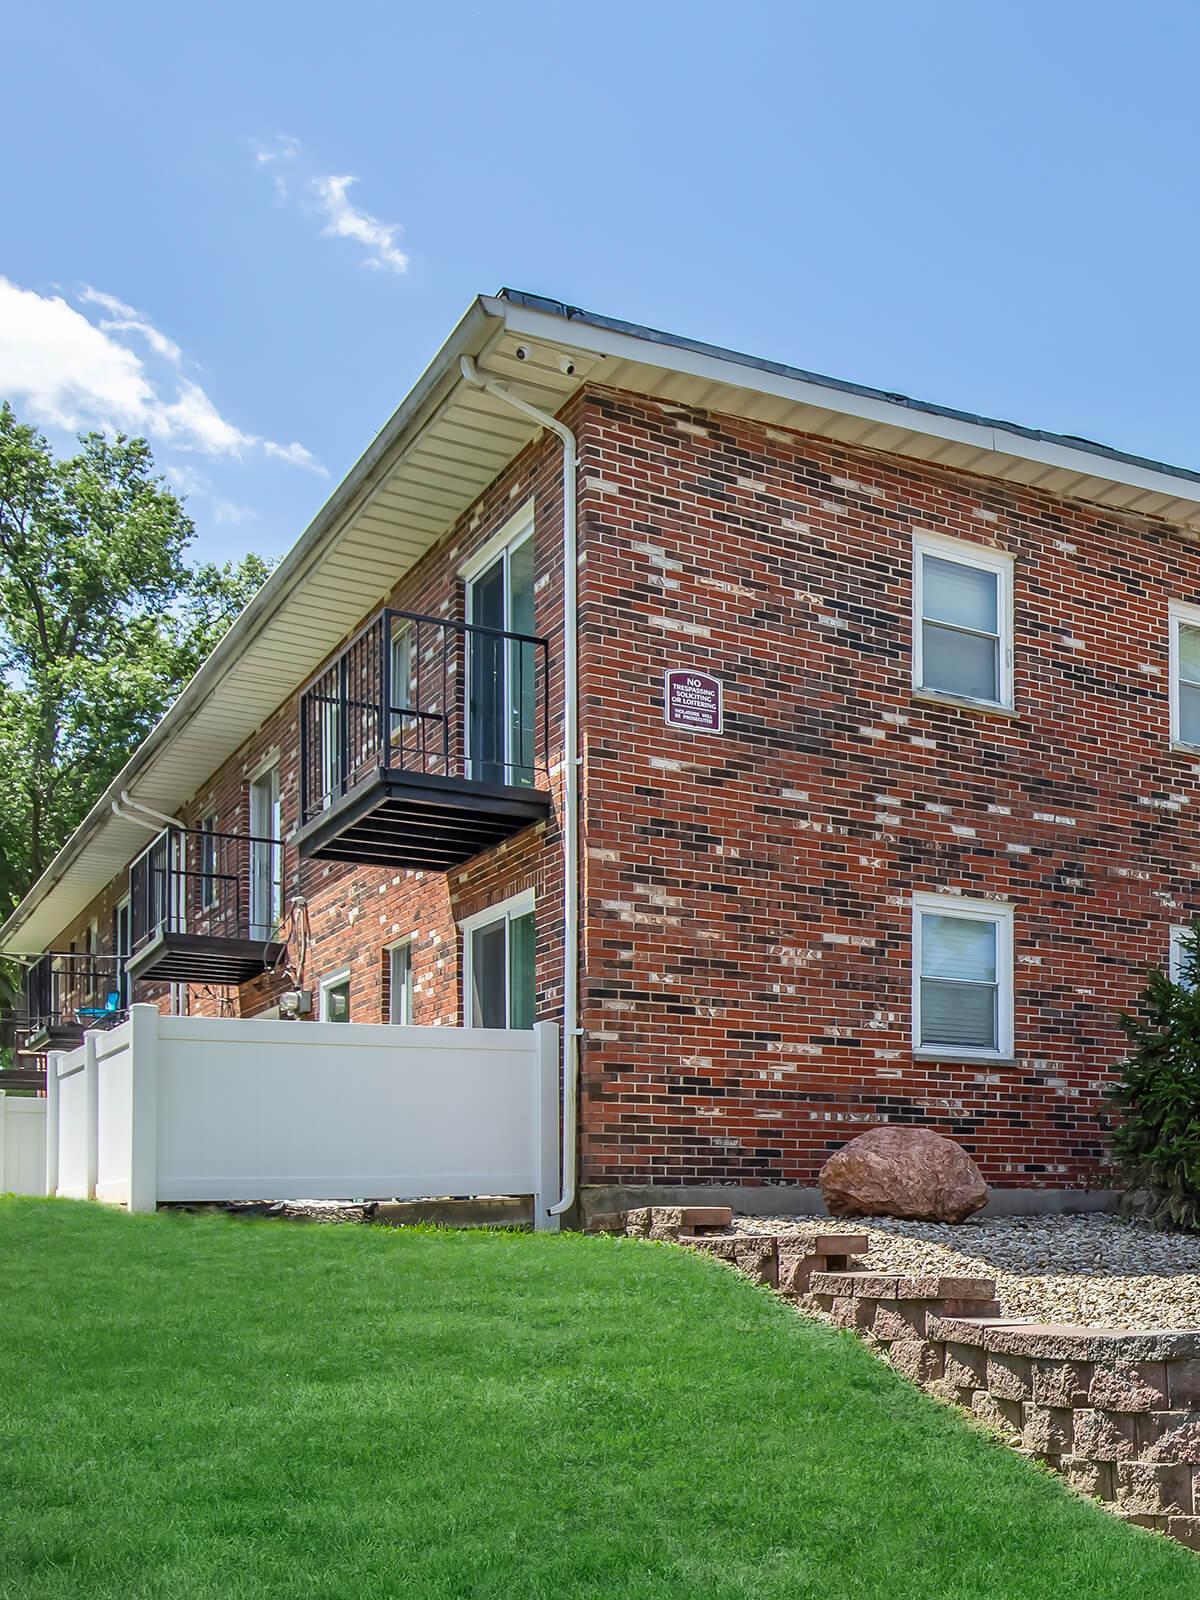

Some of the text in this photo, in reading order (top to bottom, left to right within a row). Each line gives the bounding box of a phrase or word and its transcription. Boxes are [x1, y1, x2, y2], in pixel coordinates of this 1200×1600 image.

[686, 677, 702, 688] NO
[672, 683, 716, 697] TRESPASSING
[676, 691, 712, 702] SOLICITING
[683, 698, 717, 710] LOITERING
